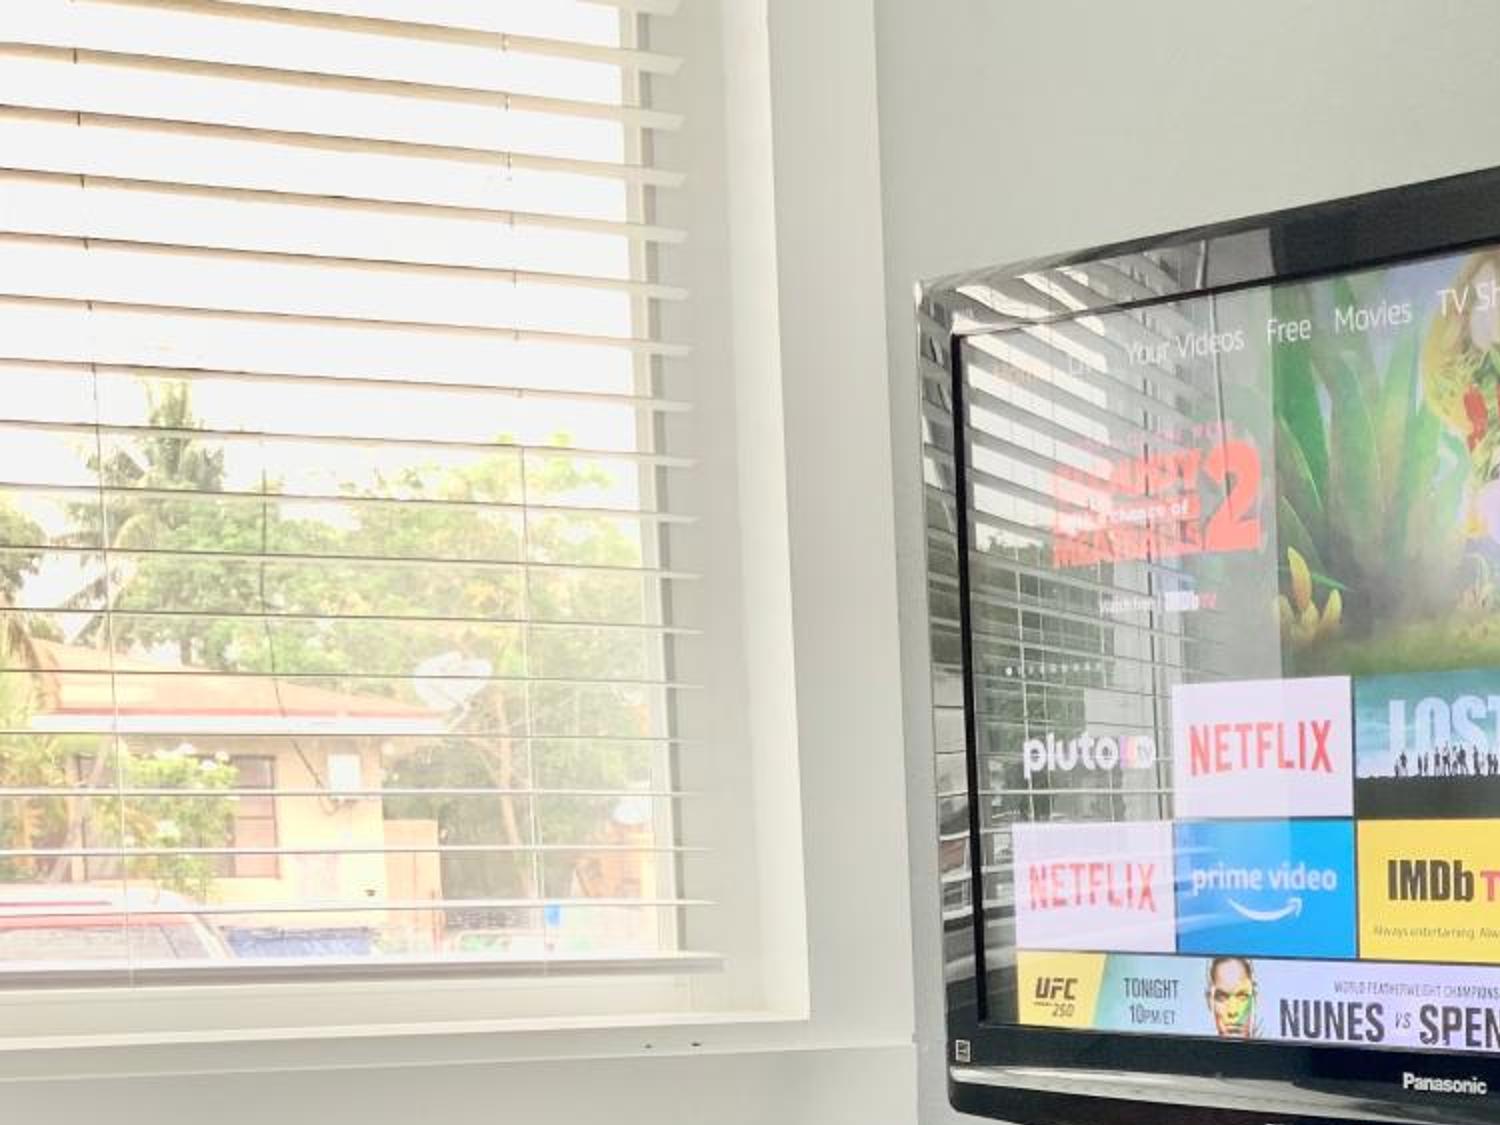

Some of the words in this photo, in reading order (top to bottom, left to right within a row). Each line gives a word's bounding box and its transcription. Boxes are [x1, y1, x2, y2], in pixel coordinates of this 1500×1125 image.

[1335, 302, 1412, 334] Movies
[1437, 288, 1471, 315] TV
[1126, 343, 1169, 365] Your
[1176, 330, 1245, 359] Videos
[1267, 318, 1312, 345] Free
[1023, 732, 1119, 780] pluto
[1188, 720, 1334, 777] NETFLIX
[1028, 863, 1157, 913] NETFLIX
[1192, 862, 1262, 896] prime
[1267, 863, 1337, 891] video
[1387, 859, 1475, 902] IMDb
[1035, 977, 1078, 1000] UFC
[1123, 977, 1180, 1000] TONIGHT
[1279, 998, 1386, 1043] NUNES
[1402, 1071, 1488, 1096] Panasonic
